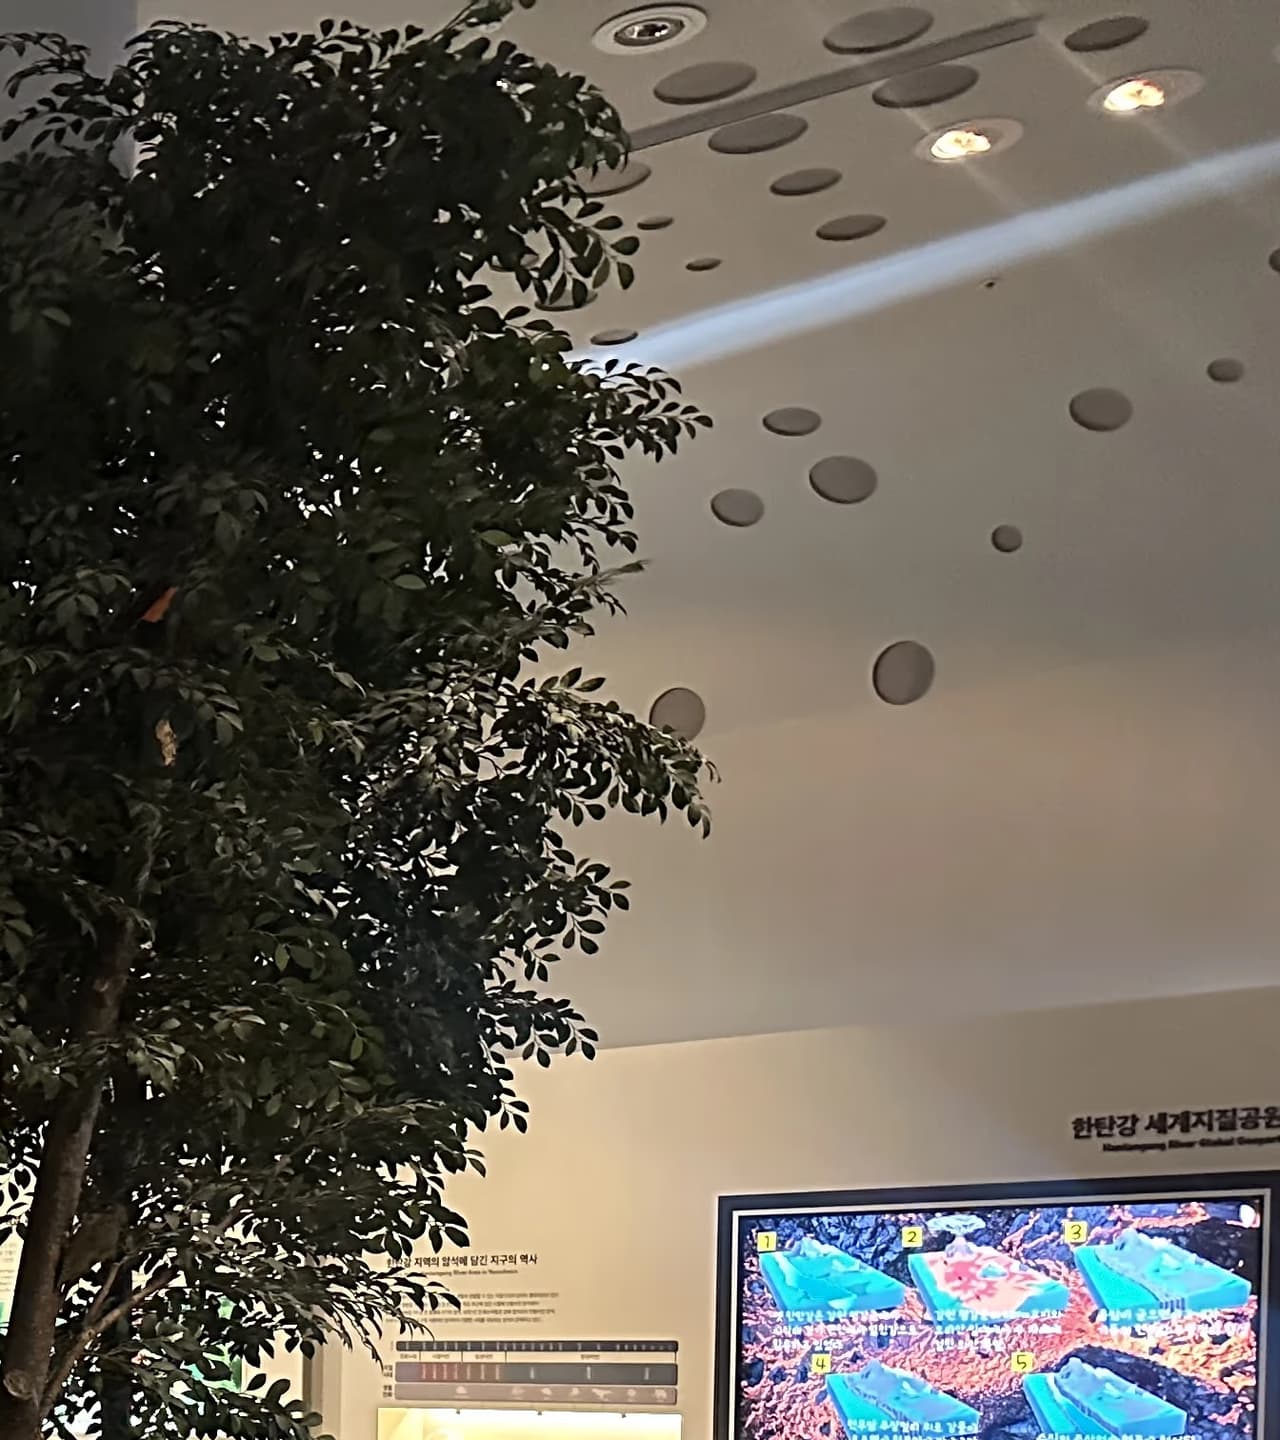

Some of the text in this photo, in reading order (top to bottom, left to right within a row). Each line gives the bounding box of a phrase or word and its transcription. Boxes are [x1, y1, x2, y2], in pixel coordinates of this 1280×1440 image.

[1071, 1105, 1280, 1140] 한탄강 세계지질공원
[413, 1256, 440, 1268] 지역의
[471, 1255, 488, 1266] 담긴
[490, 1254, 517, 1265] 지구의
[520, 1253, 538, 1265] 역사
